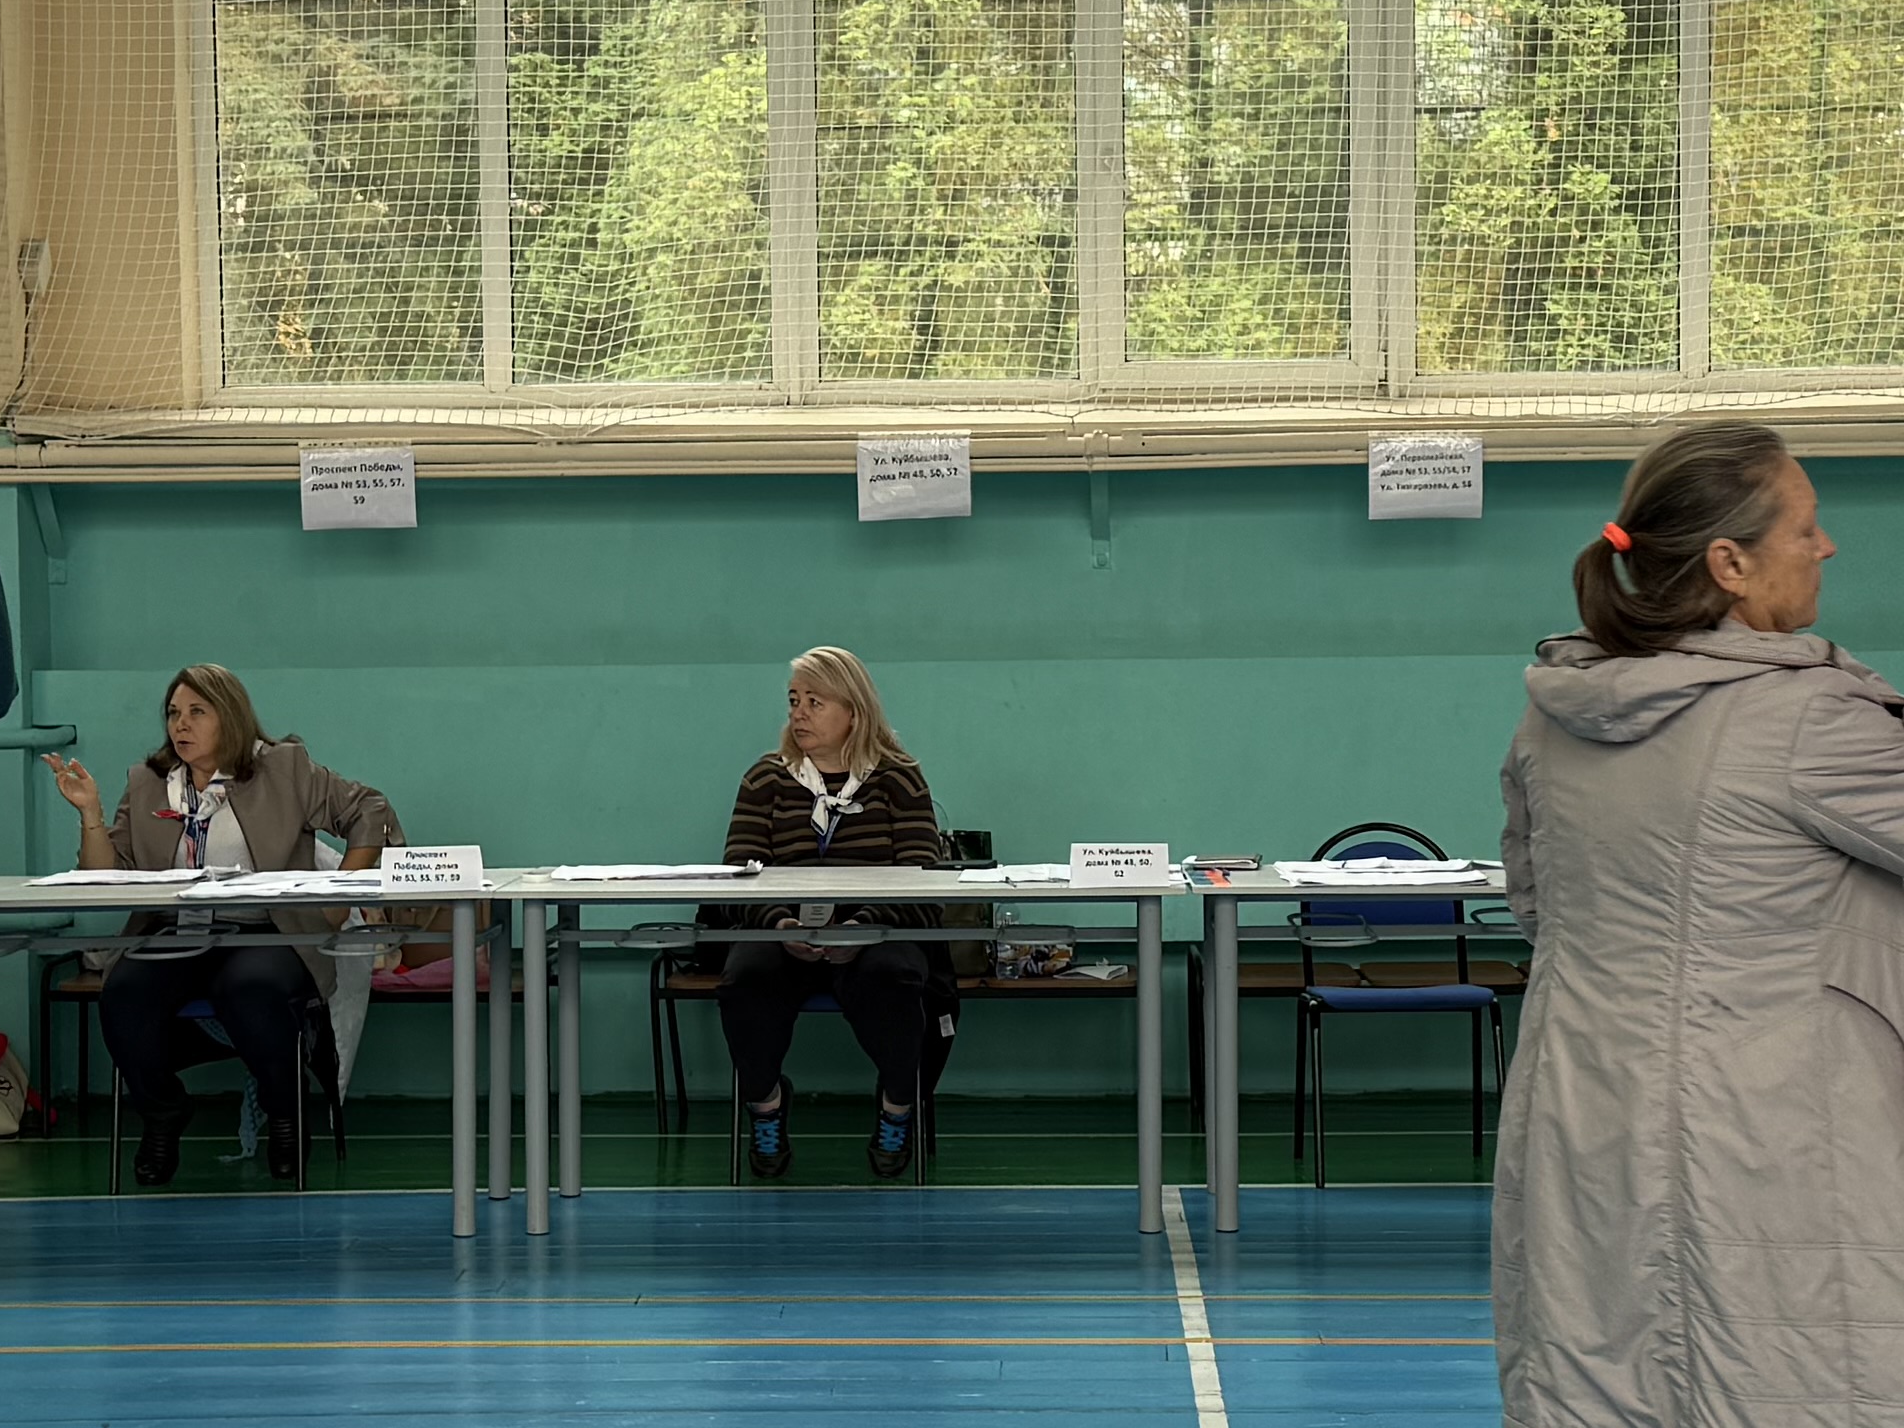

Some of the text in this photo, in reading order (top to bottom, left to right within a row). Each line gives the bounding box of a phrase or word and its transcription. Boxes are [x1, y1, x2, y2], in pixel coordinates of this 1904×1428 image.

[311, 462, 403, 476] Проспект Победы,
[1380, 469, 1403, 477] дома
[869, 474, 896, 483] дома
[930, 468, 945, 479] 50,
[311, 482, 338, 492] дома
[355, 479, 371, 489] 53,
[372, 478, 388, 488] 55,
[389, 477, 405, 488] 57,
[353, 495, 366, 505] 59
[405, 851, 447, 860] Проспект
[435, 863, 459, 871] дома
